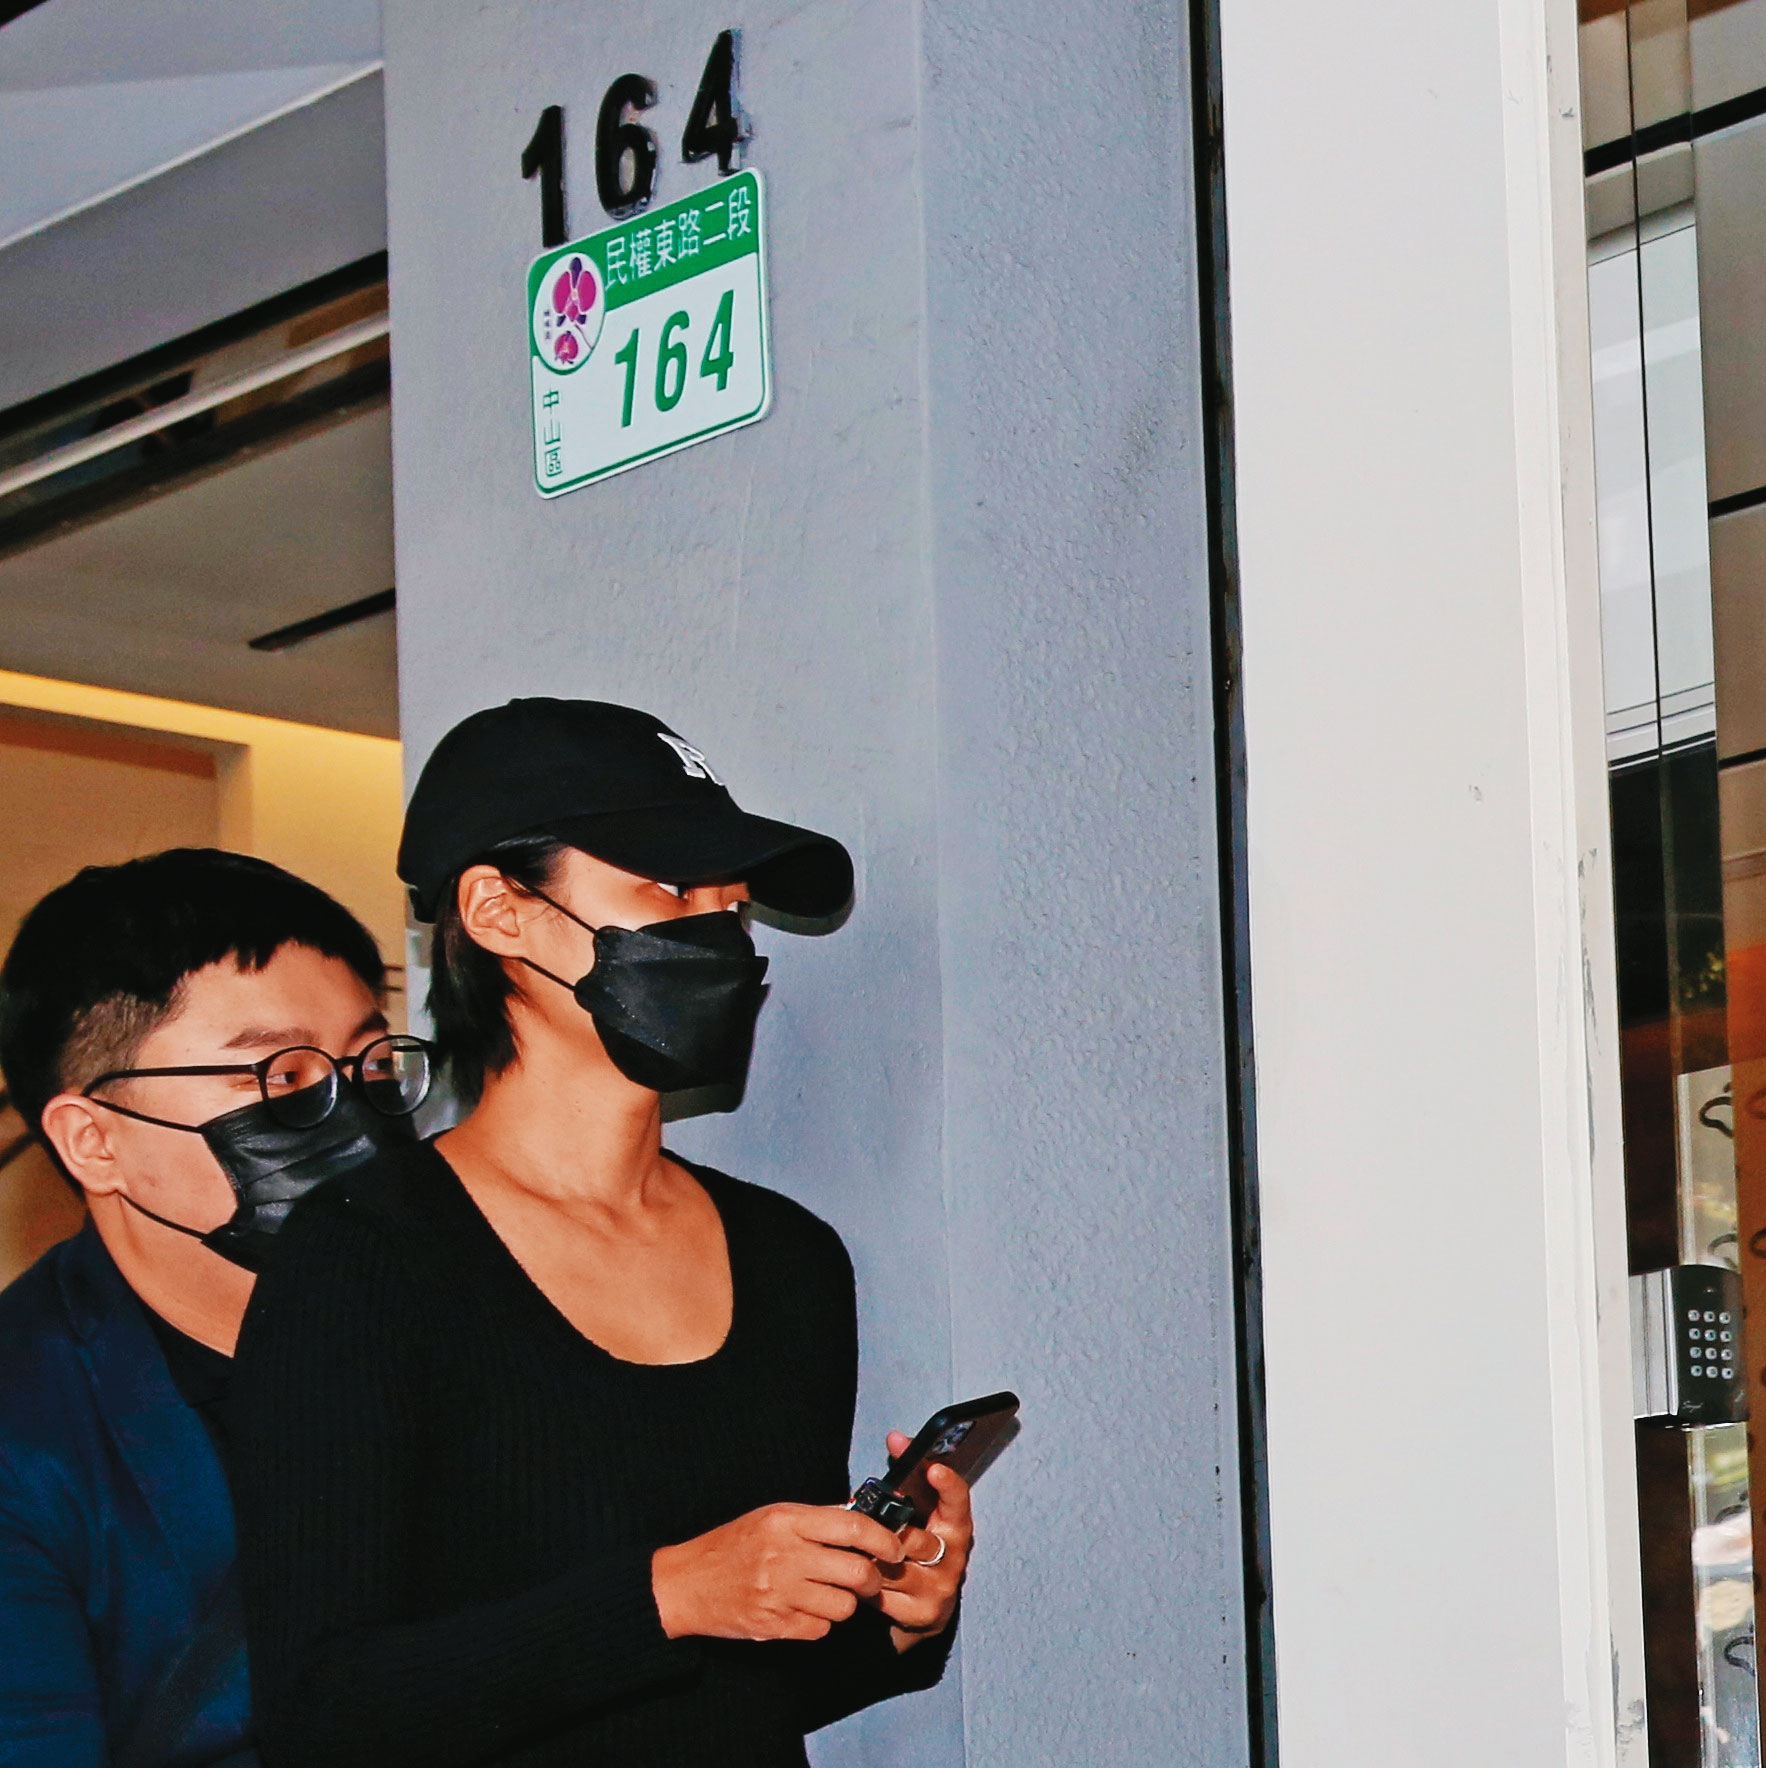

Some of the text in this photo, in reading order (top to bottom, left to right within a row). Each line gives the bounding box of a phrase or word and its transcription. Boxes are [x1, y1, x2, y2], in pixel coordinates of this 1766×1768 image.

[520, 28, 754, 248] 164
[604, 187, 753, 293] 民權東路二段
[613, 288, 736, 428] 164
[541, 387, 564, 478] 中山區
